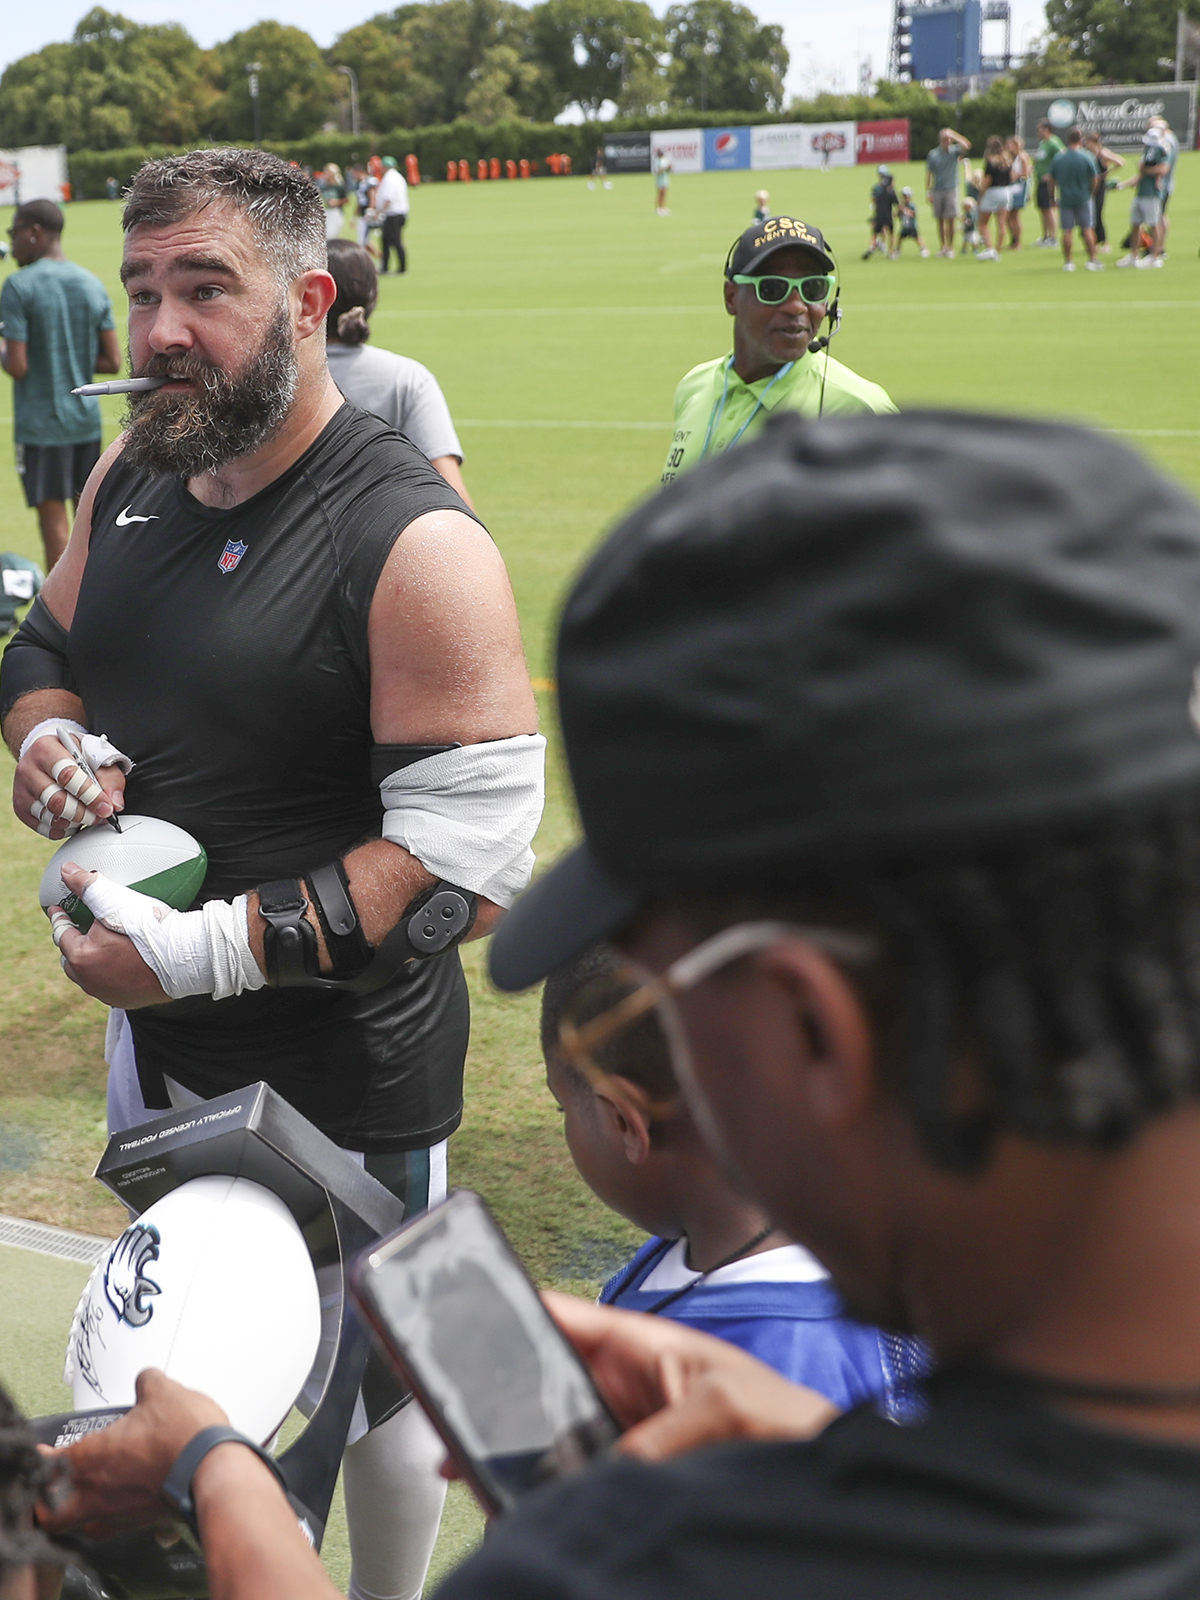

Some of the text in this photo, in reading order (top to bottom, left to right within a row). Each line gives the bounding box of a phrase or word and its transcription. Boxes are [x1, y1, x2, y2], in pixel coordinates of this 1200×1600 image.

[1076, 98, 1165, 121] NovaCare
[764, 217, 807, 234] CSC
[754, 228, 817, 248] EVENT STAFF
[221, 552, 239, 569] NFL
[119, 1104, 242, 1151] OFFICIALLY LICENSED FOOTBALL
[62, 1418, 116, 1434] OOTBALL
